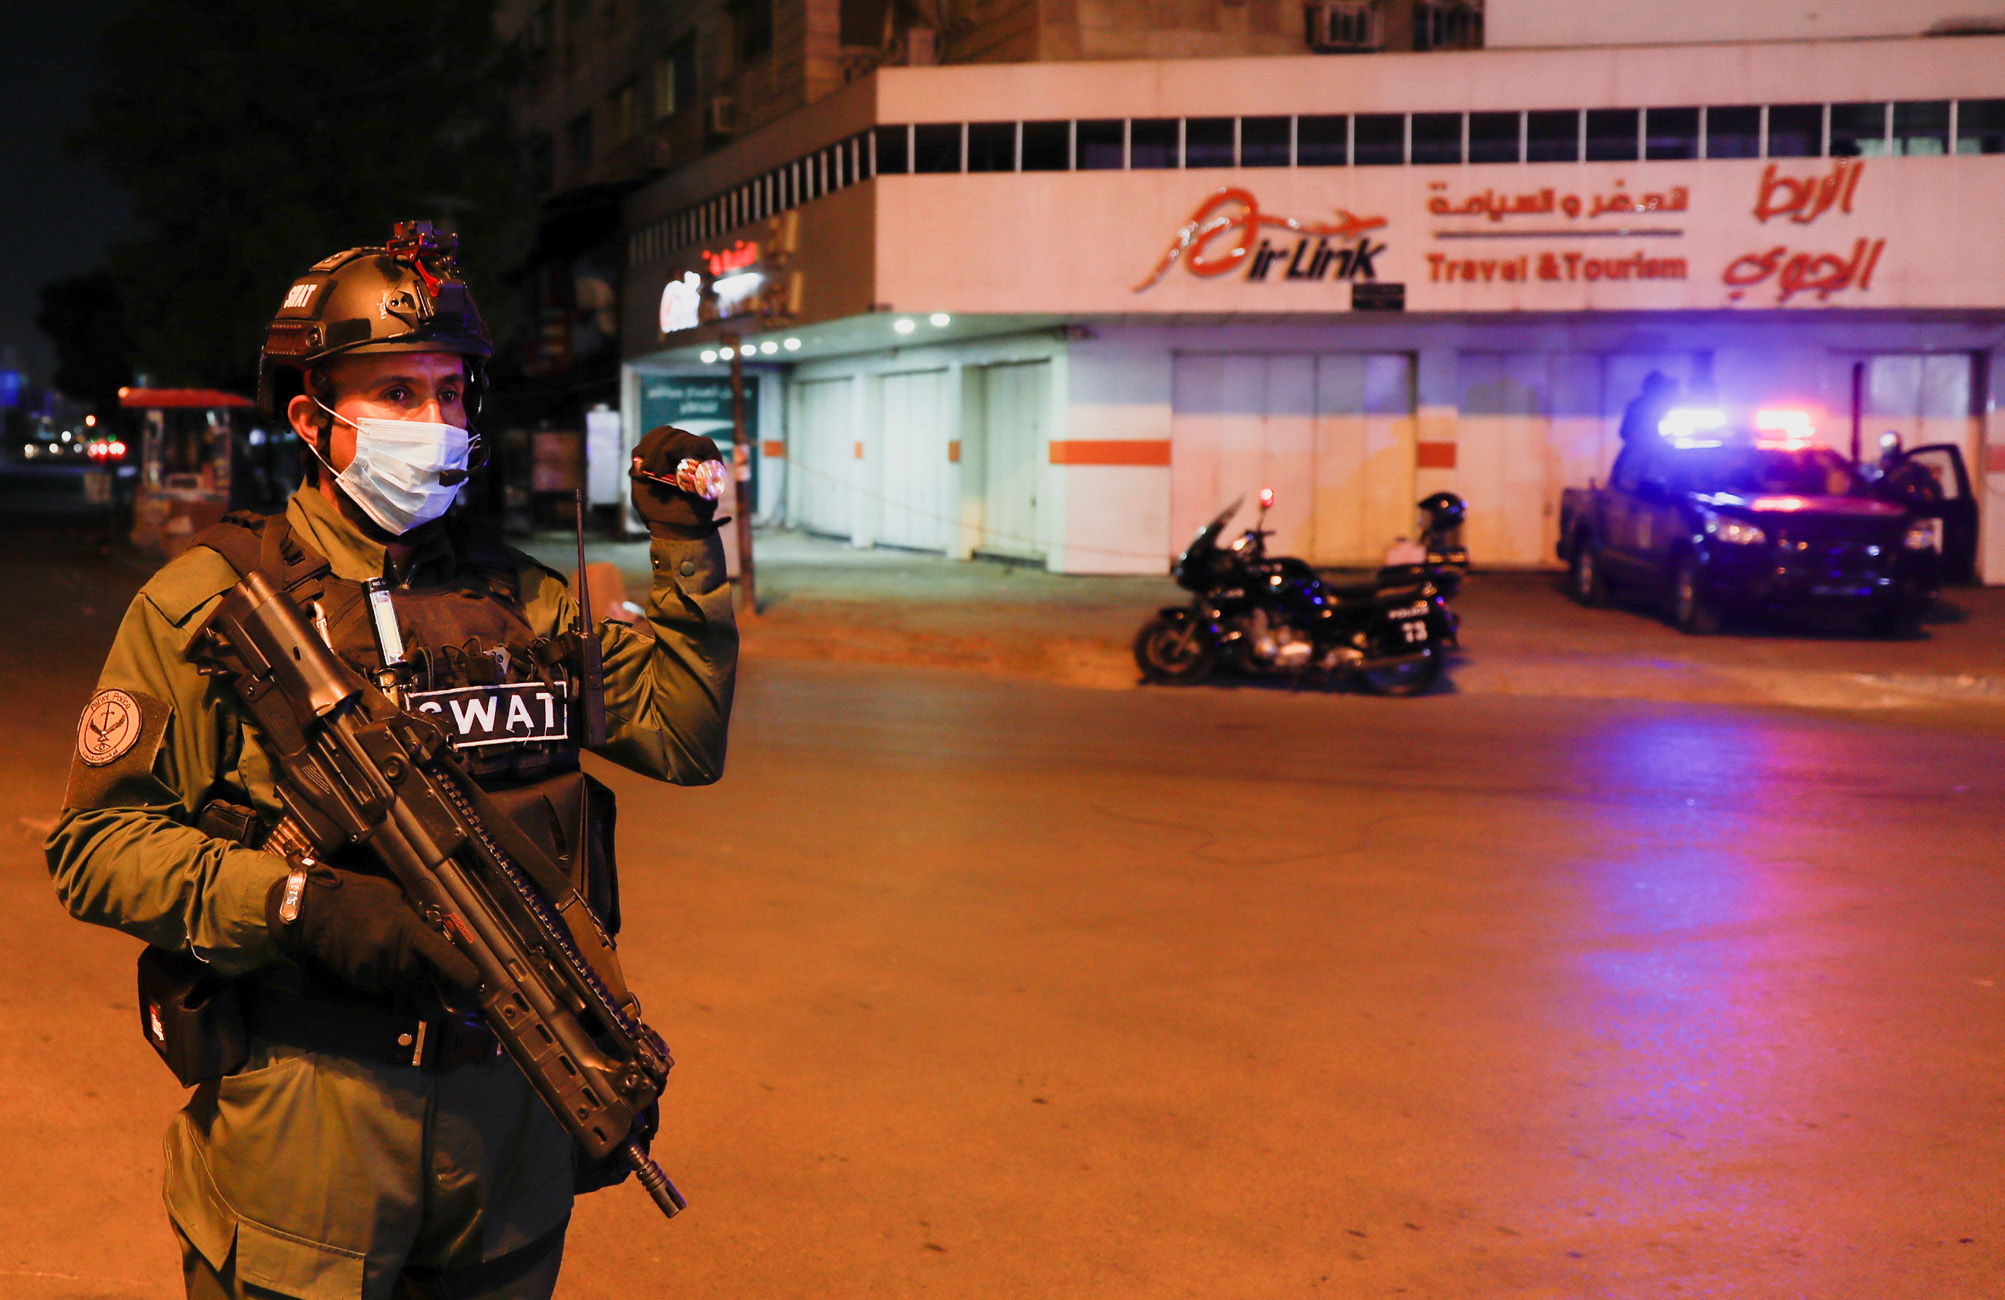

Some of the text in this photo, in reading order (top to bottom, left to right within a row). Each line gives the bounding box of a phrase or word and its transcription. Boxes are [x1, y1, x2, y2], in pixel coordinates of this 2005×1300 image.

[1753, 159, 1864, 225] الربط
[1427, 252, 1528, 281] Travel
[1722, 237, 1886, 303] الجوي
[283, 283, 318, 309] SWAT
